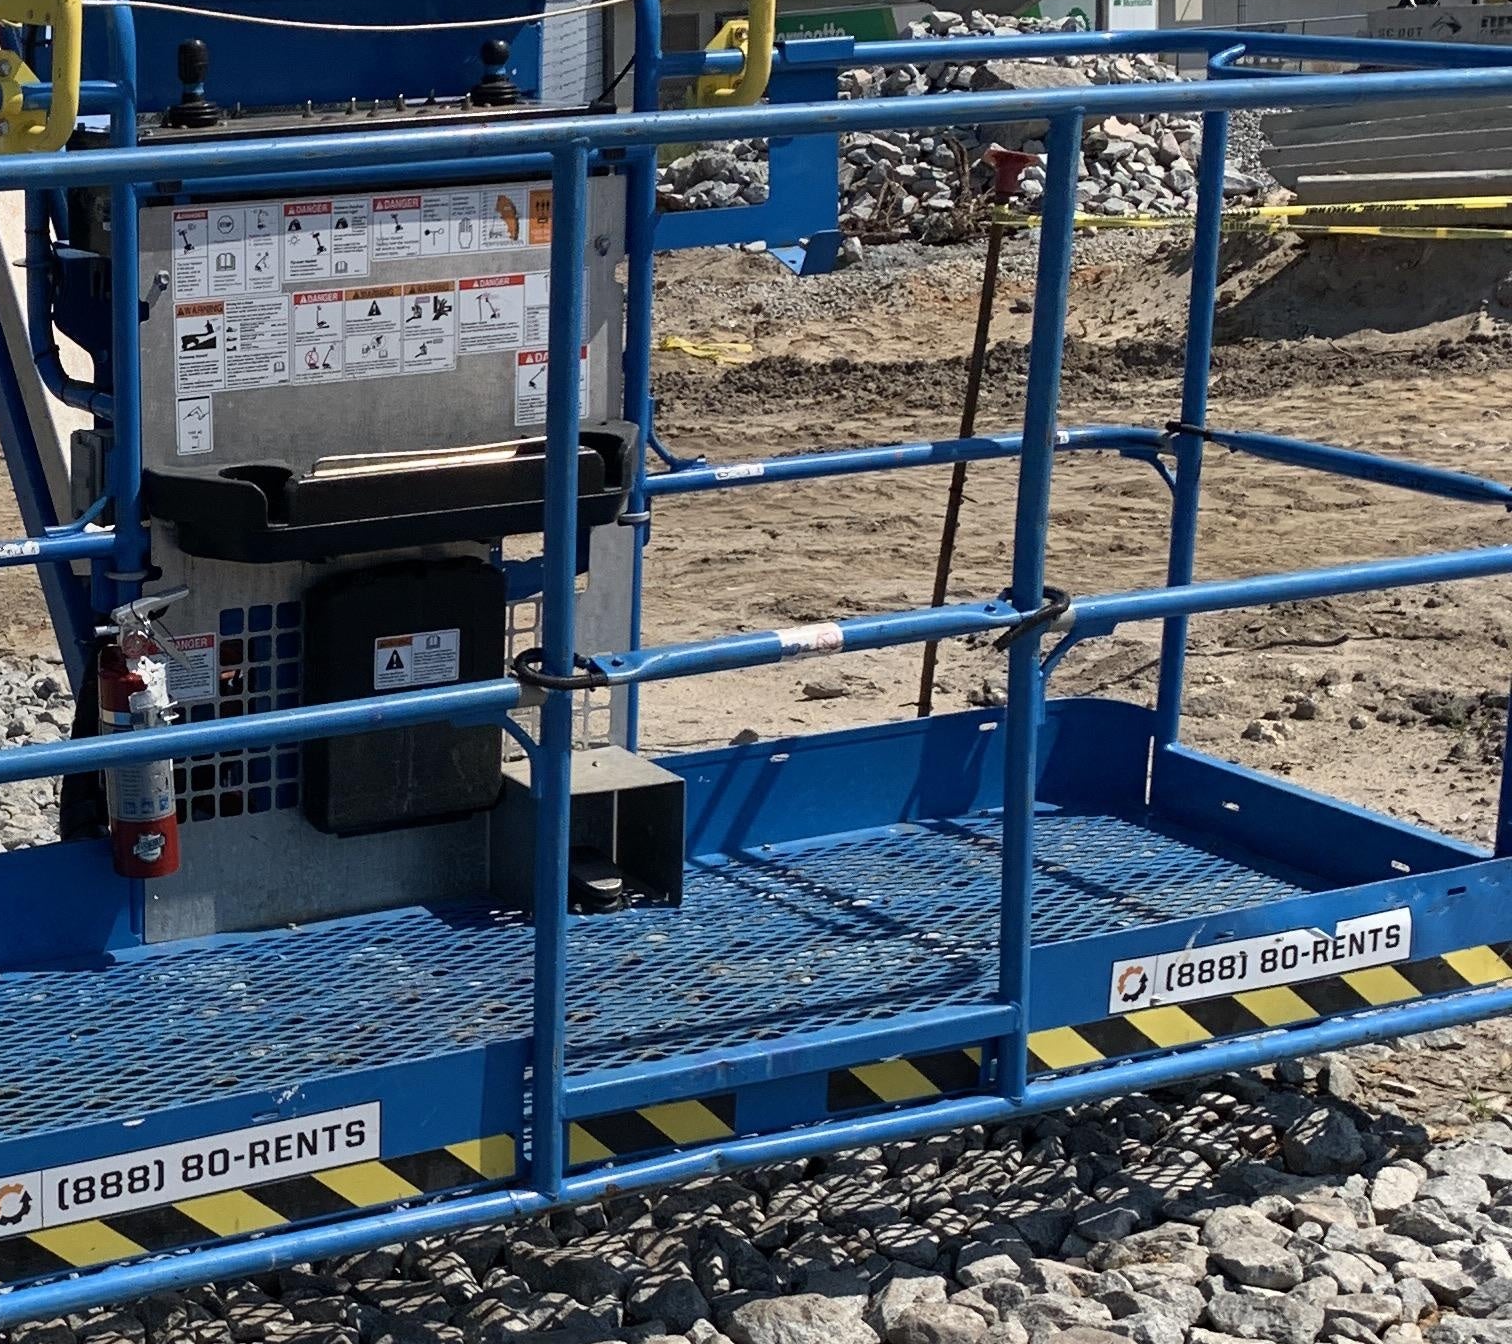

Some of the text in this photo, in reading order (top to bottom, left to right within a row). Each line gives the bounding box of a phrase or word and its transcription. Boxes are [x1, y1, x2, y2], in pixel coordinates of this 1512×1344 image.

[295, 203, 328, 214] DANGER
[383, 197, 420, 209] DANGER
[480, 277, 510, 287] DANGER
[308, 293, 338, 304] DANGER
[183, 304, 223, 315] WARNING
[1166, 924, 1401, 992] (888) 80-RENTS
[58, 1119, 366, 1211] (888) 80-RENTS
